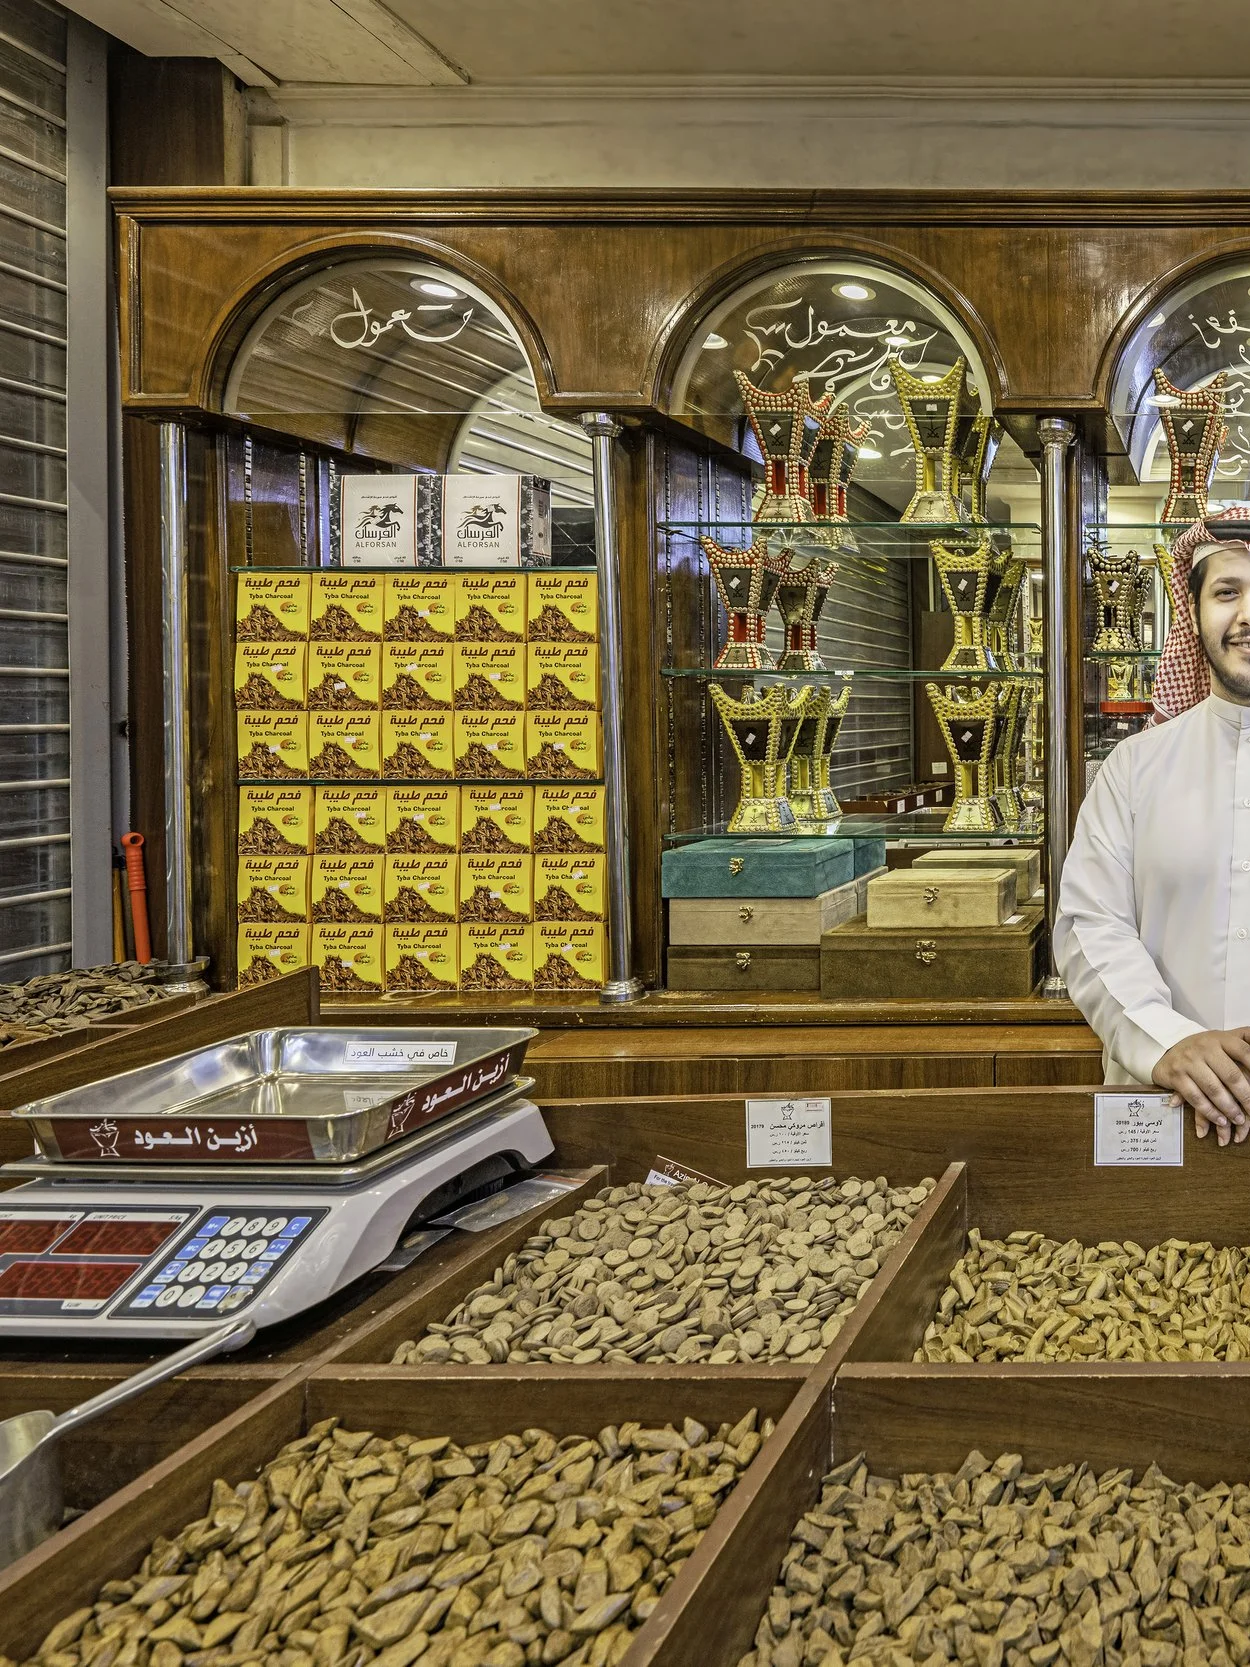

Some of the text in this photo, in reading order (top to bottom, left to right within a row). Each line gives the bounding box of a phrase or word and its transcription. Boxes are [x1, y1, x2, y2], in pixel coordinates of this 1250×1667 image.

[355, 525, 397, 541] الفرسان
[457, 525, 500, 541] الفرسان
[245, 578, 300, 592] فحم طيبة
[320, 577, 376, 592] فحم طيبة
[393, 578, 447, 593] فحم طيبة
[462, 578, 516, 593] فحم طيبة
[536, 578, 588, 592] فحم طيبة
[317, 646, 371, 661] فحم طيبة
[535, 647, 588, 661] فحم طيبة
[245, 715, 298, 730] فحم طيبة
[247, 790, 301, 805] فحم طيبة
[393, 790, 448, 805] فحم طيبة
[245, 860, 299, 874] فحم طيبة
[468, 859, 522, 873] فحم طيبة
[393, 928, 448, 942] فحم طيبة
[351, 1048, 448, 1060] خاص في خشب العود
[422, 1053, 510, 1113] أزين العود
[134, 1124, 258, 1152] أزين العود
[232, 1222, 239, 1231] 7
[250, 1222, 259, 1231] 8
[270, 1222, 279, 1230] 9
[208, 1244, 215, 1253] 4
[230, 1244, 239, 1253] 5
[249, 1244, 258, 1253] 6
[184, 1267, 240, 1276] 1 2 3
[164, 1290, 174, 1300] 0
